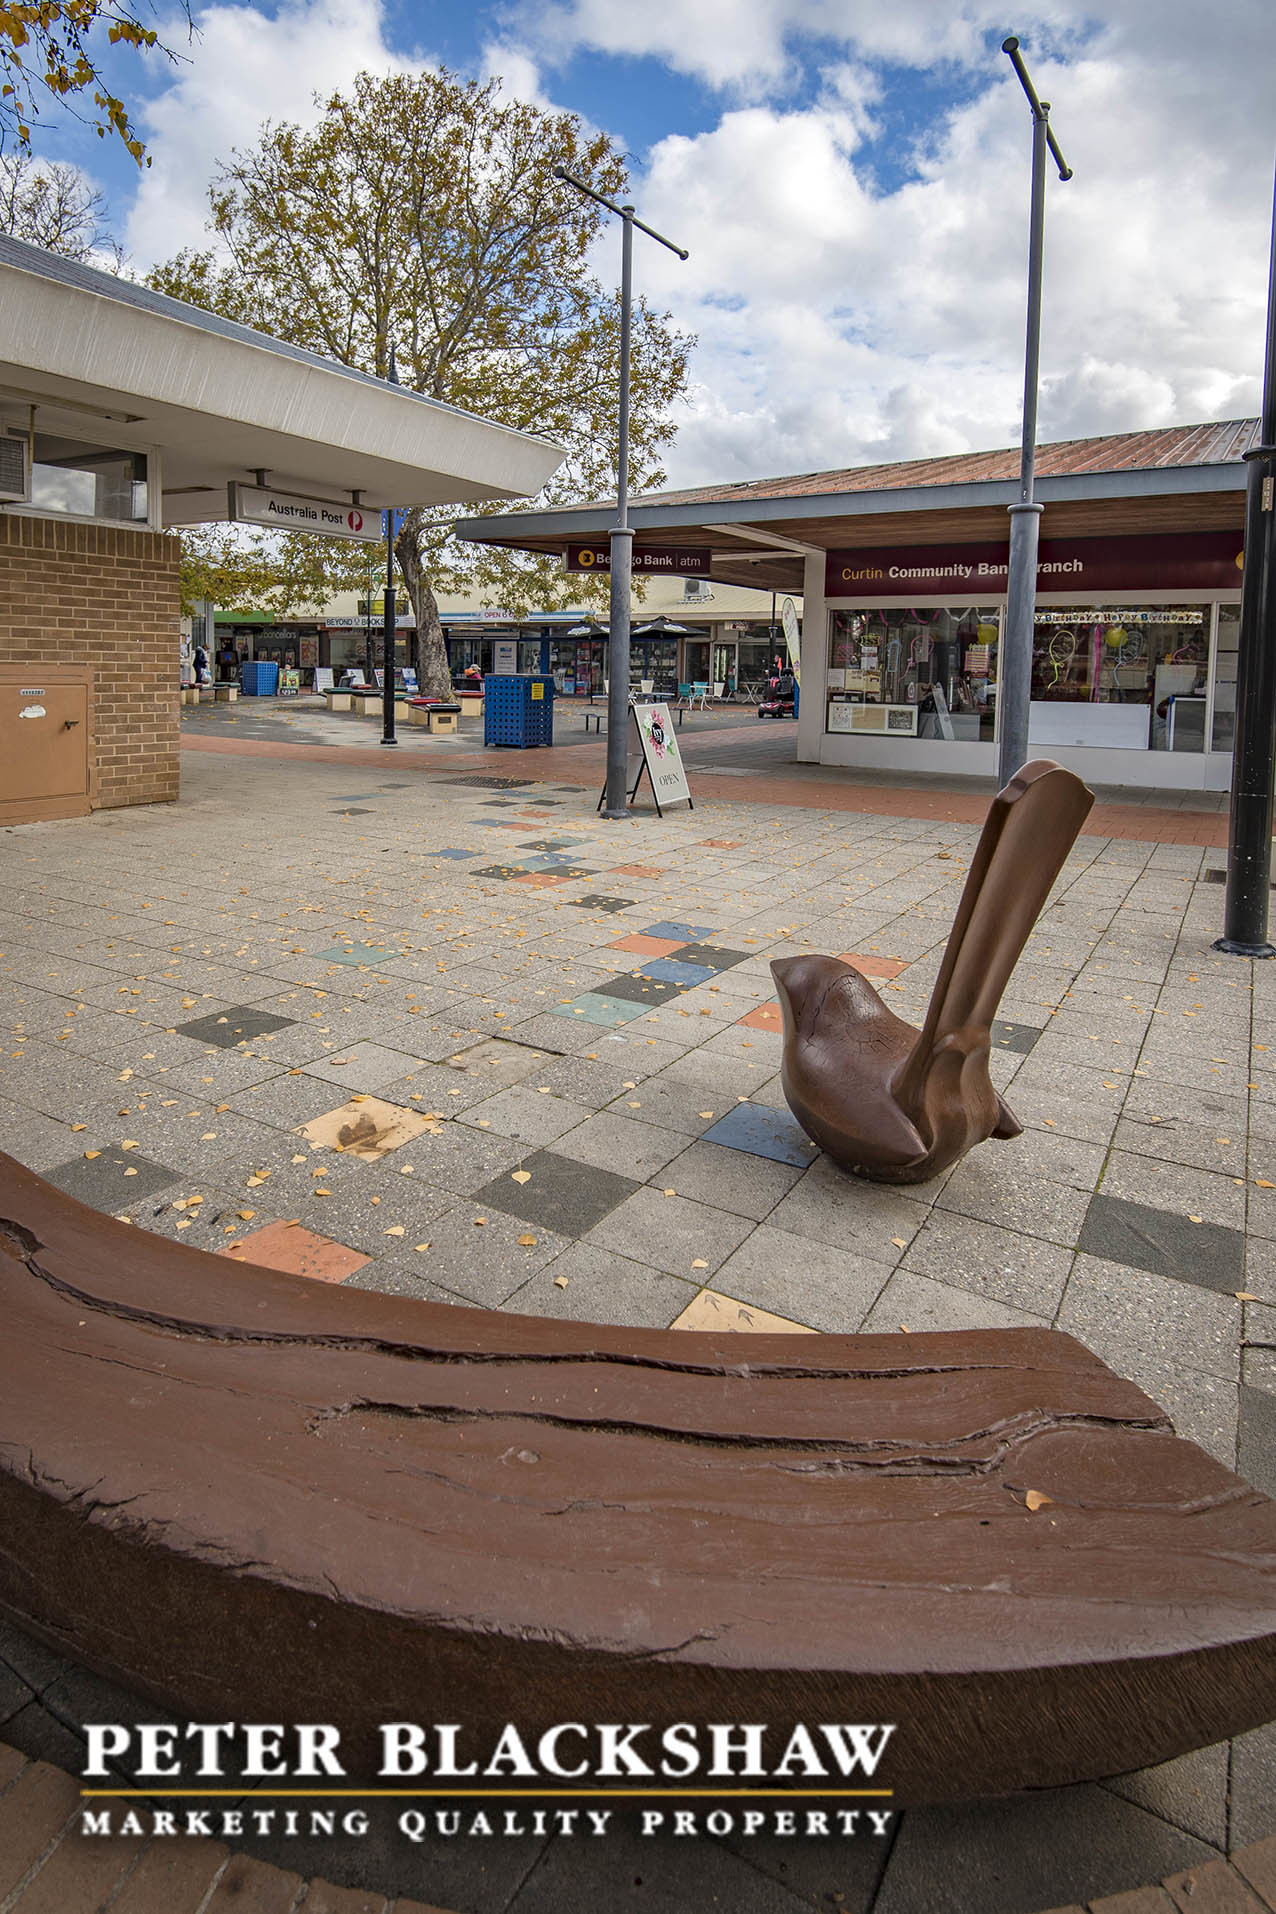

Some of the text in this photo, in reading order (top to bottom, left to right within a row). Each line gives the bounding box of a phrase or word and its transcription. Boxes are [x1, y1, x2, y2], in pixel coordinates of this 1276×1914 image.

[268, 500, 343, 524] Australia Post
[596, 553, 700, 567] Bego Bank atm
[841, 559, 1083, 580] Curtin Community Ban ranch
[326, 618, 353, 626] BEYOND
[484, 611, 501, 619] OPEN
[658, 772, 680, 786] OPEN
